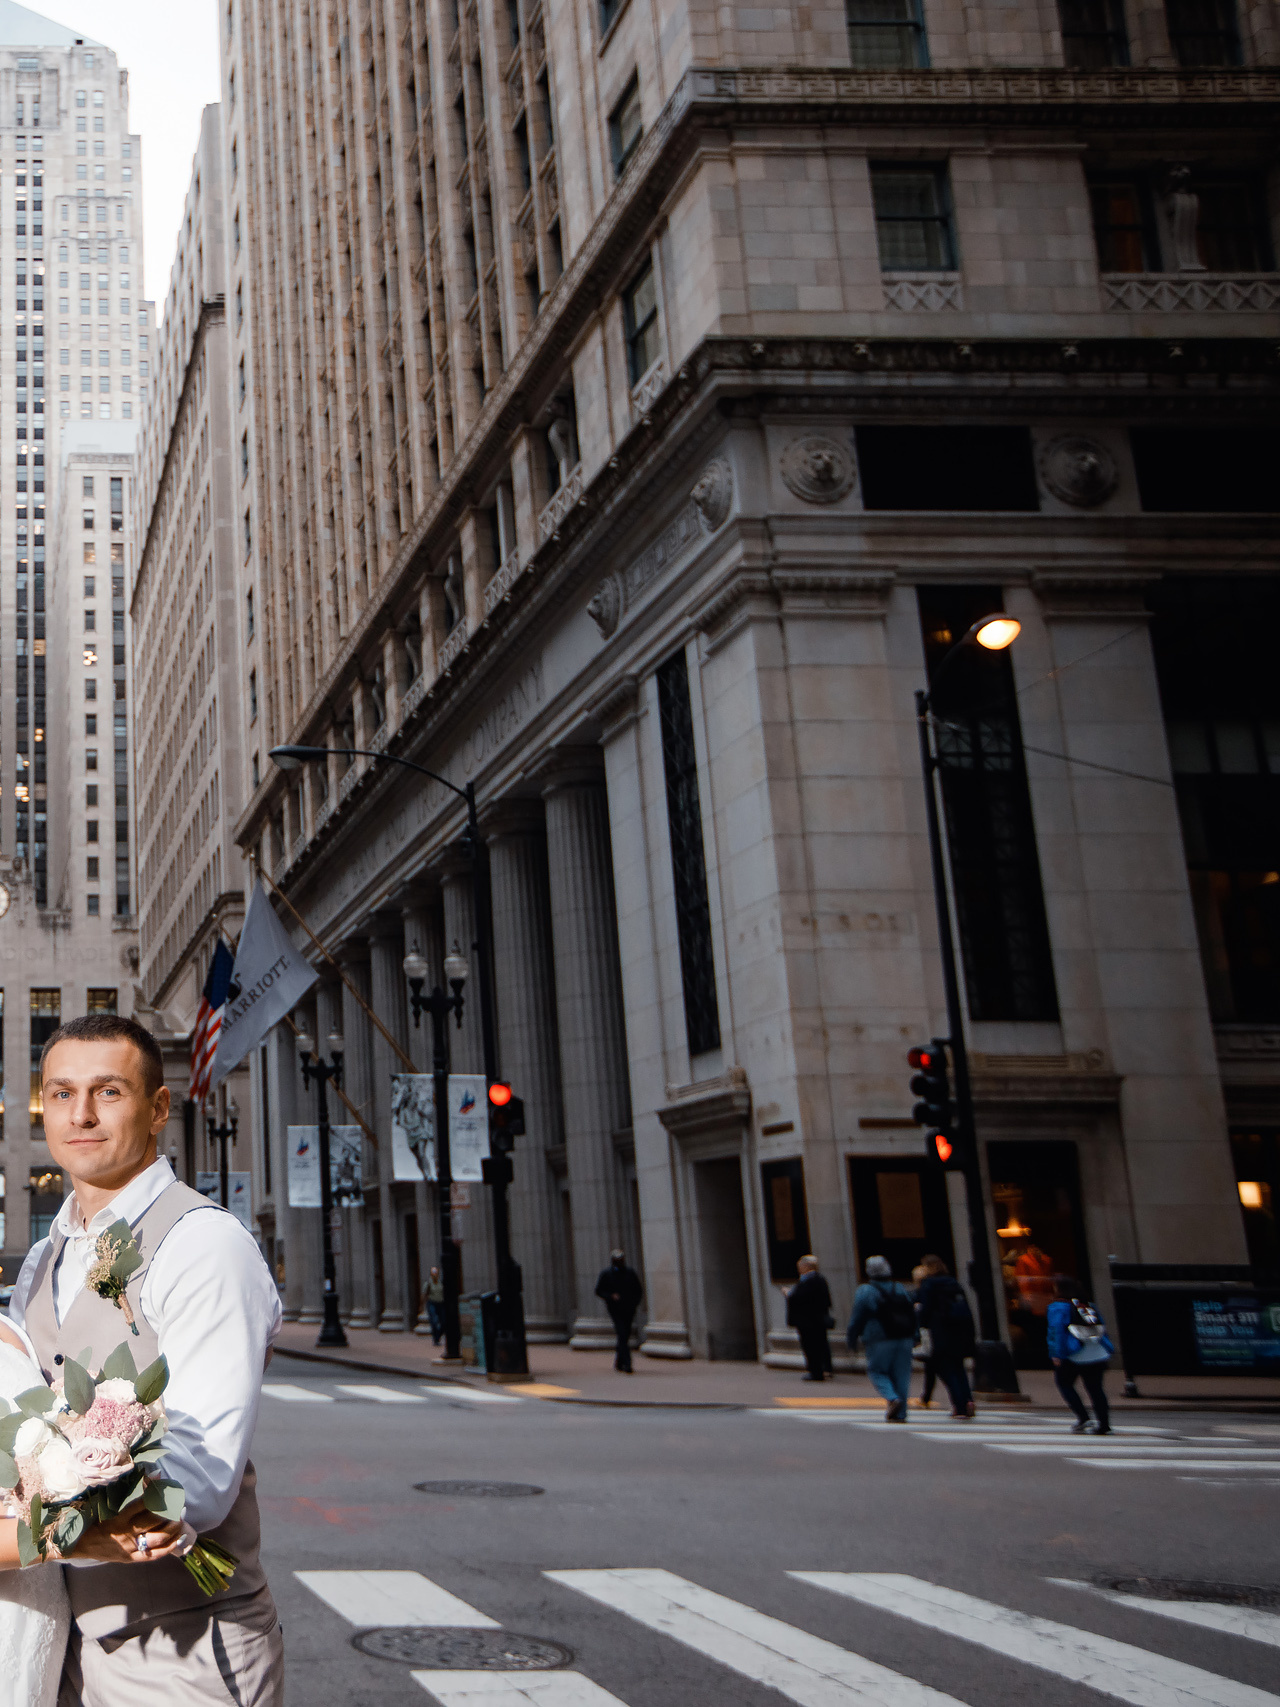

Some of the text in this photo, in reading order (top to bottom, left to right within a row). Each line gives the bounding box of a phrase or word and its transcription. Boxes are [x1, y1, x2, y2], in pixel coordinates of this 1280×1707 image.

[461, 656, 545, 776] COMPANY
[24, 947, 47, 961] OF
[55, 947, 108, 961] TRADE
[220, 954, 288, 1034] MARRIOTT
